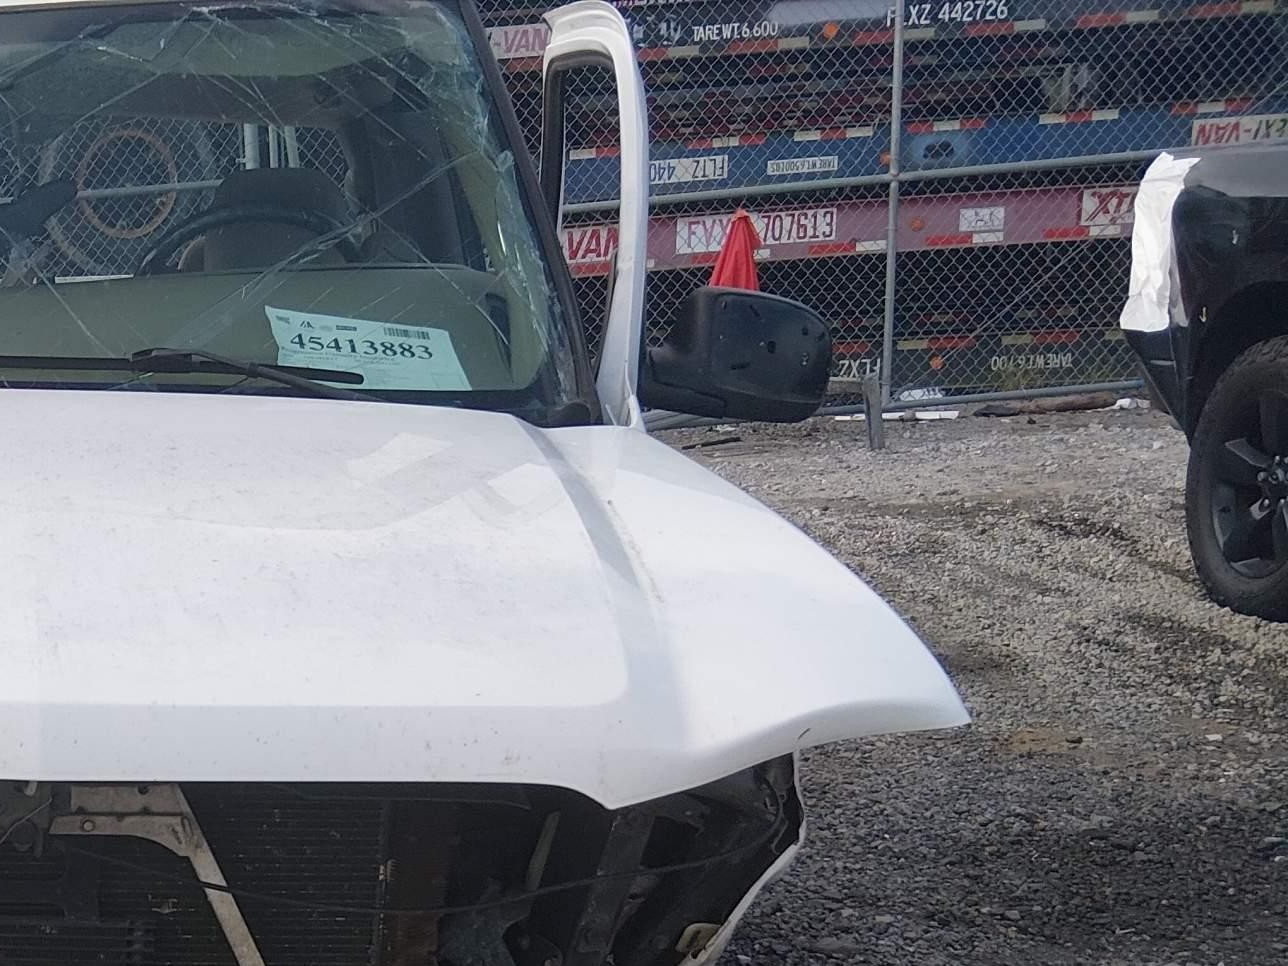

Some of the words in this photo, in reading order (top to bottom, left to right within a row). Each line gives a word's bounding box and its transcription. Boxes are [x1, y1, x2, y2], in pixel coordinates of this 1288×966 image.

[938, 1, 1008, 22] 442726
[692, 23, 720, 41] TARE
[692, 156, 725, 178] FLTZ
[687, 218, 731, 249] FVX
[762, 209, 835, 242] 707613
[290, 333, 433, 360] 45413883
